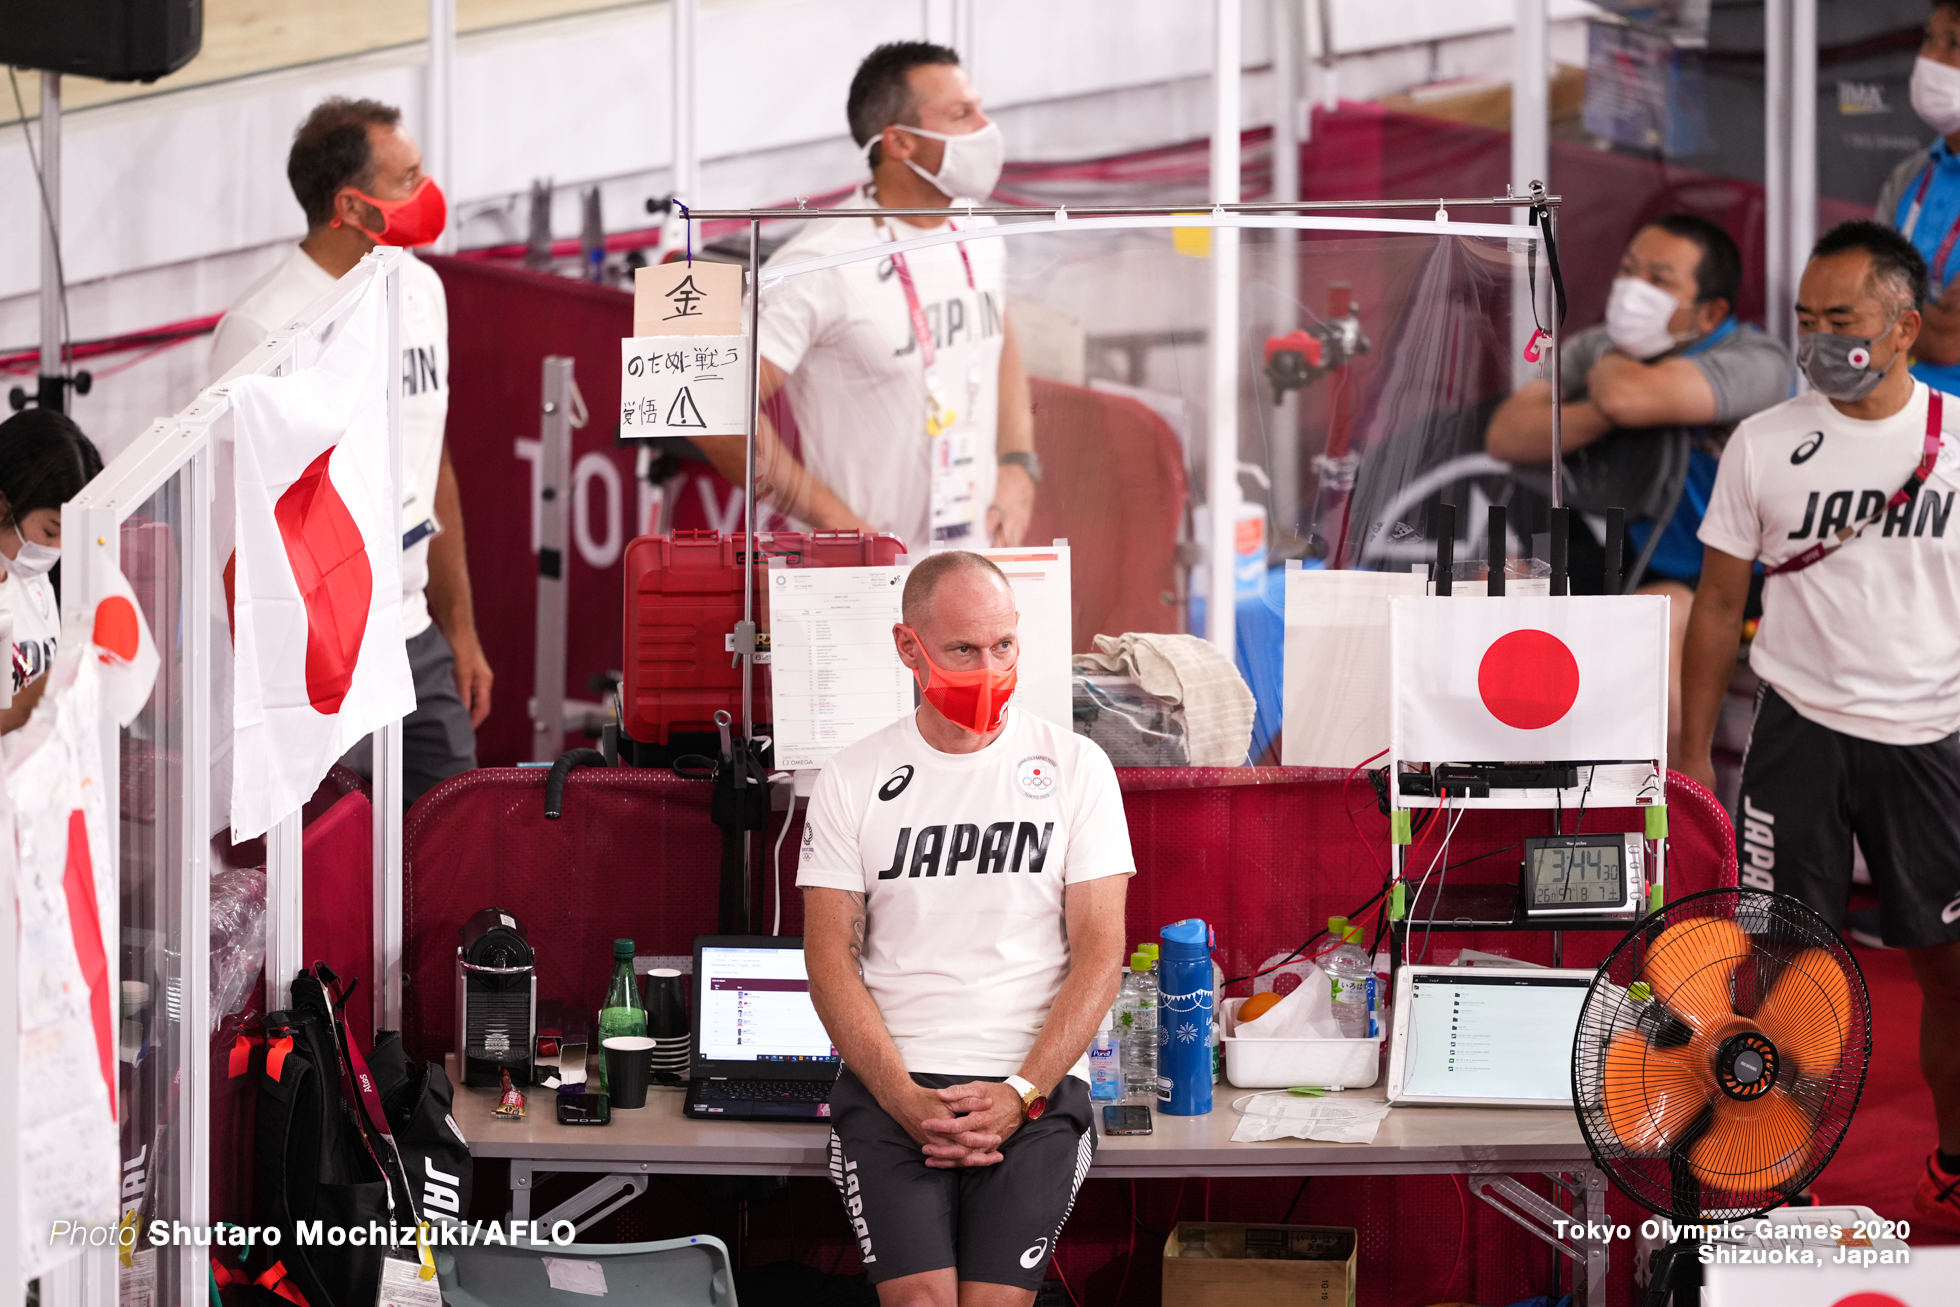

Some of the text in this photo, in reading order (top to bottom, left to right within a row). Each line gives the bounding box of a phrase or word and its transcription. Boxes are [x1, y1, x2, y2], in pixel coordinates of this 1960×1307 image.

[662, 274, 708, 321] 金
[627, 346, 739, 377] のために戦う
[622, 397, 658, 426] 覚悟
[877, 821, 1055, 881] JAPAN
[1552, 849, 1618, 883] 3:44 30
[422, 1155, 460, 1222] JA
[844, 1154, 877, 1264] JAPAN
[1321, 1279, 1330, 1301] 1G-19
